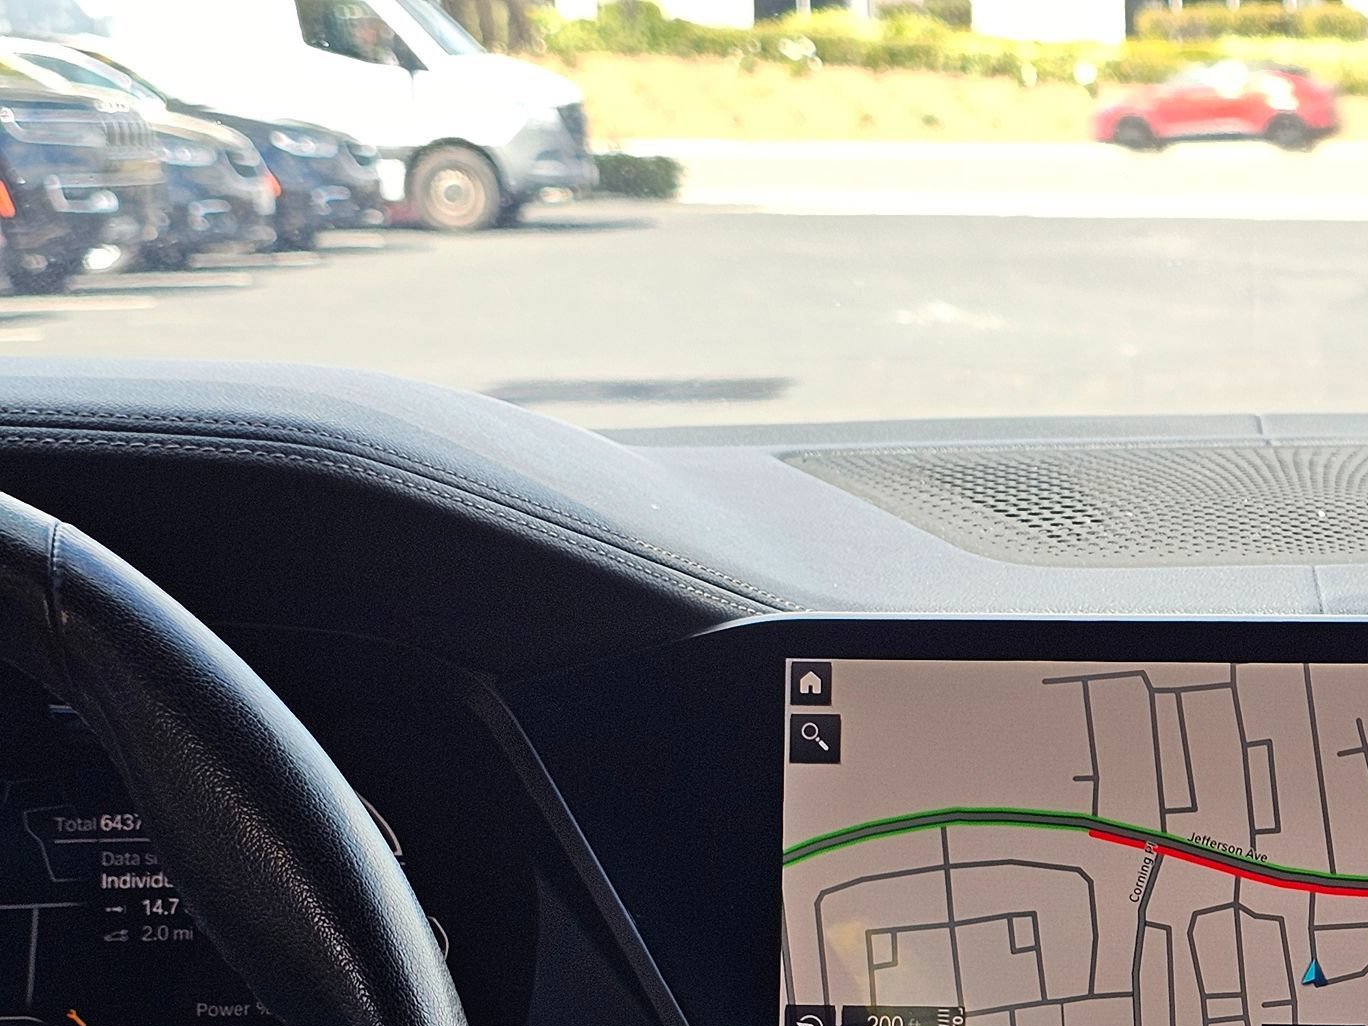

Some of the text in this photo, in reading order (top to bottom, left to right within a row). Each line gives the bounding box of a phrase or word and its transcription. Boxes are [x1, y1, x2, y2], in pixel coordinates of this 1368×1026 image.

[53, 816, 98, 832] Total
[1187, 832, 1268, 863] Jefferson Ave
[101, 851, 141, 867] Data
[1129, 856, 1154, 903] Corning
[142, 897, 180, 916] 14.7
[142, 924, 194, 942] 2.0 mi
[196, 1002, 250, 1017] Power
